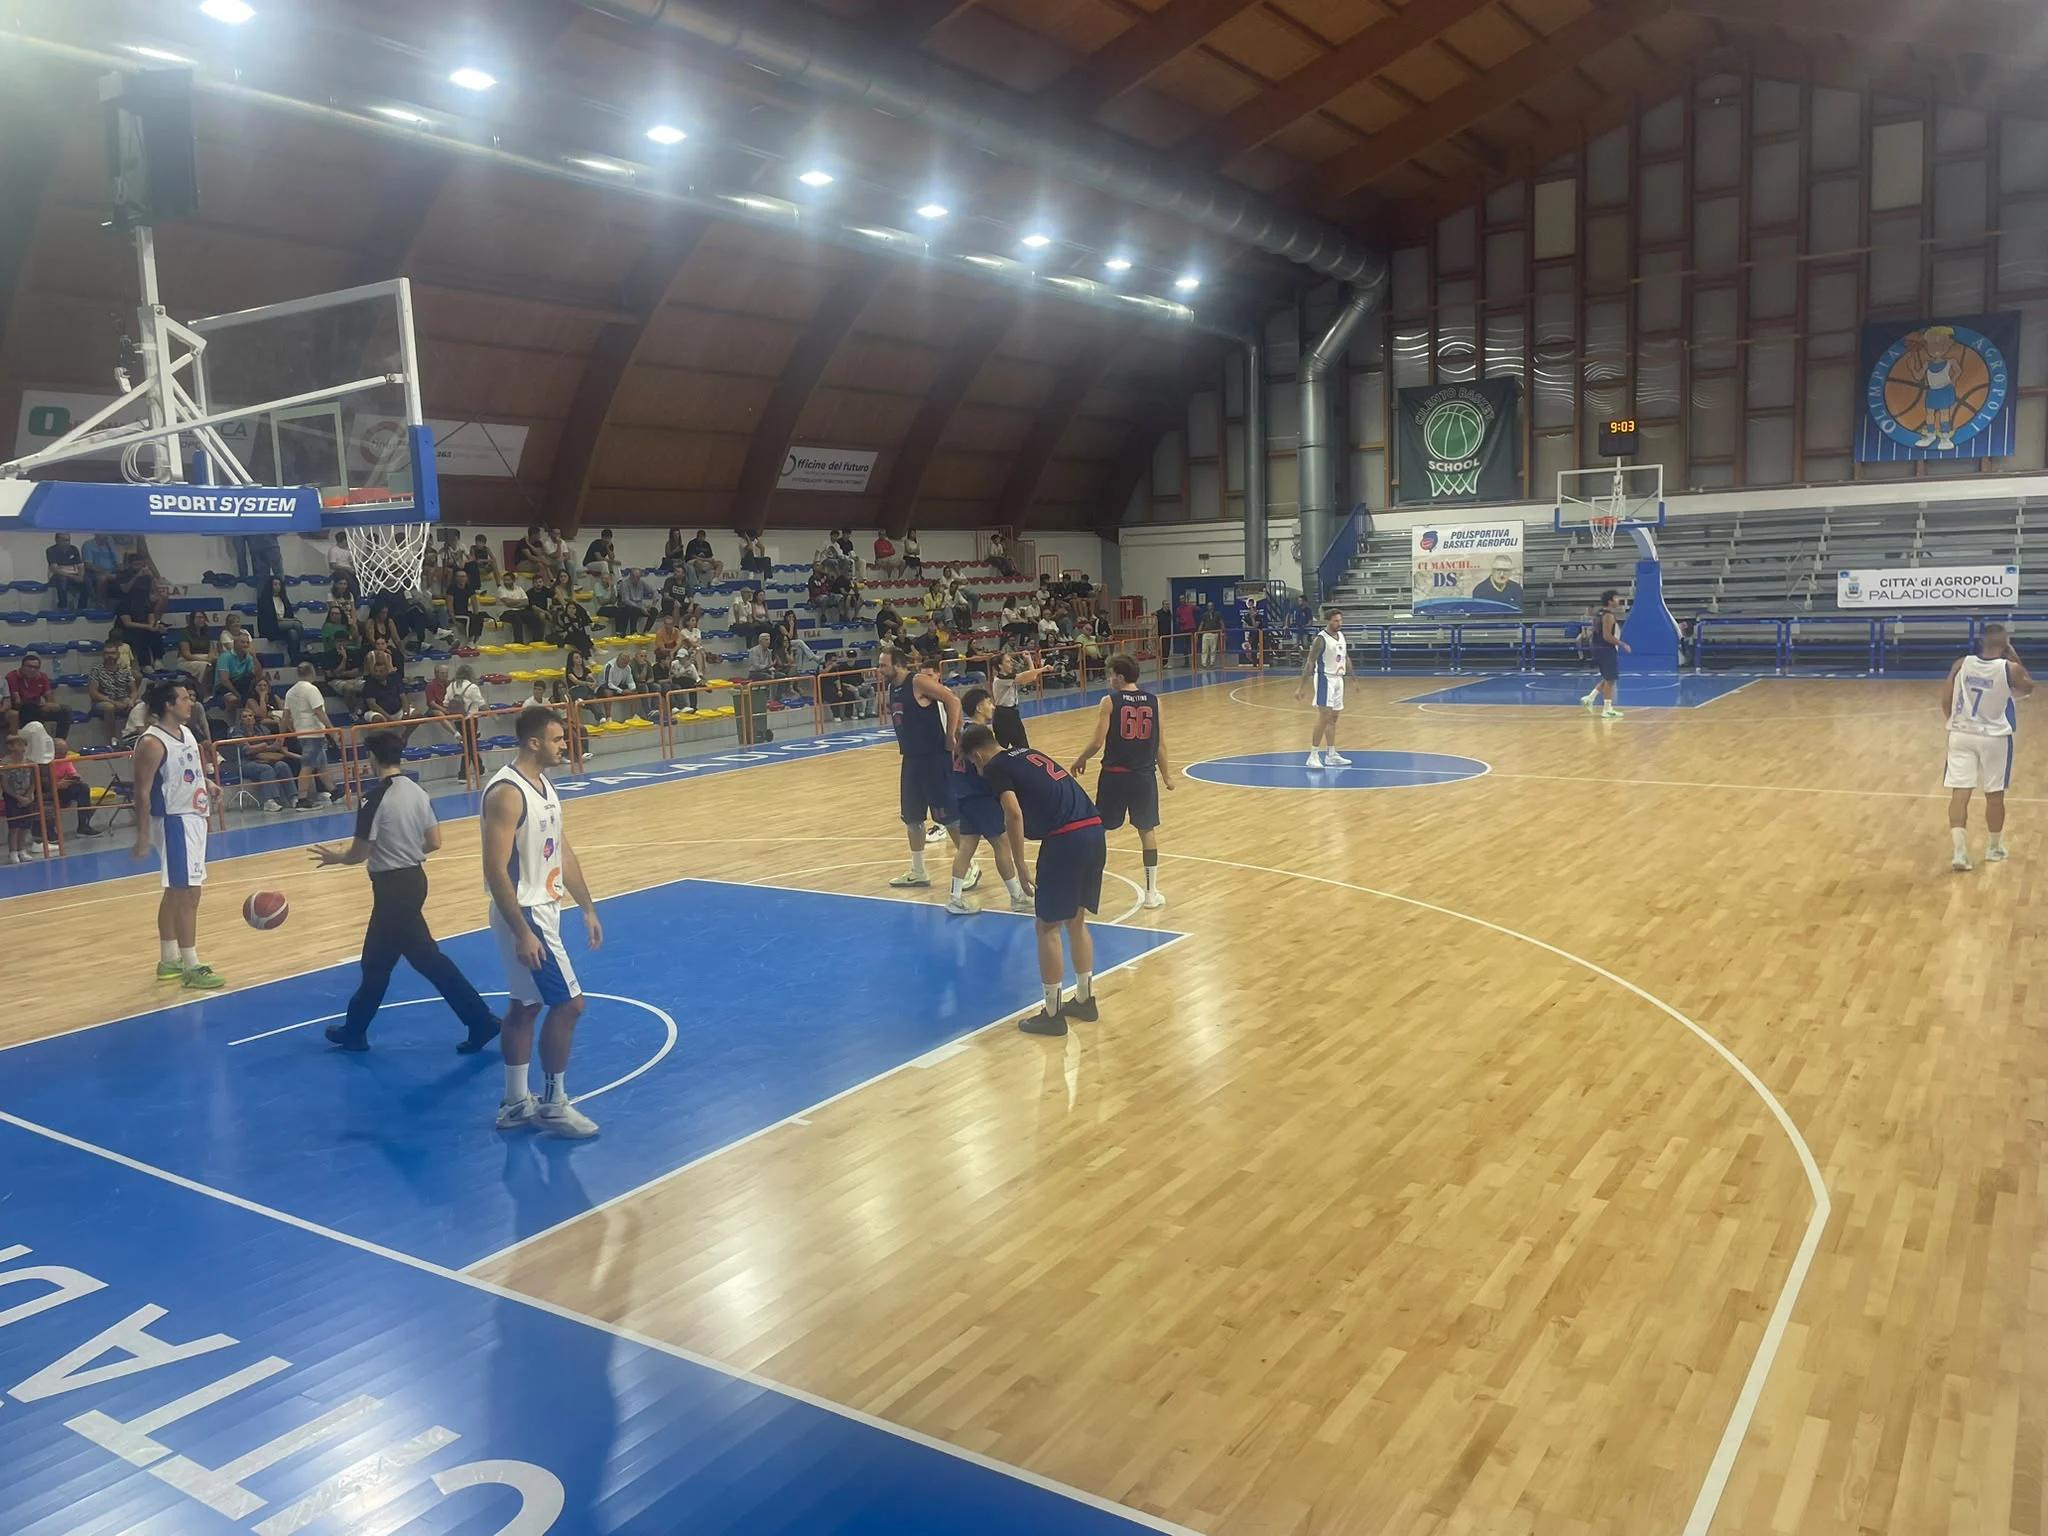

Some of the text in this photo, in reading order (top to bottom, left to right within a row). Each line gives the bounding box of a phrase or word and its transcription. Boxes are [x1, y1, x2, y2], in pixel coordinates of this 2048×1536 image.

[1869, 338, 2007, 433] OLIMPIA AGROPOLI
[1458, 387, 1495, 421] BASKET
[1610, 420, 1635, 433] 9:03
[828, 461, 842, 471] del
[843, 462, 870, 473] futuro
[1428, 458, 1480, 472] SCHOOL
[149, 494, 297, 514] SPORT SYSTEM
[1450, 529, 1510, 540] POLISPORTIVA
[1443, 538, 1519, 549] BASKET AGROPOLI
[1433, 572, 1458, 587] DS
[1880, 575, 2003, 588] CITTA' di AGROPOLI
[1869, 587, 2014, 600] PALADICONCILIO
[1971, 688, 1984, 717] 7
[1120, 705, 1153, 740] 66
[555, 763, 728, 791] PALA
[711, 751, 789, 762] DI
[1026, 753, 1069, 781] 2
